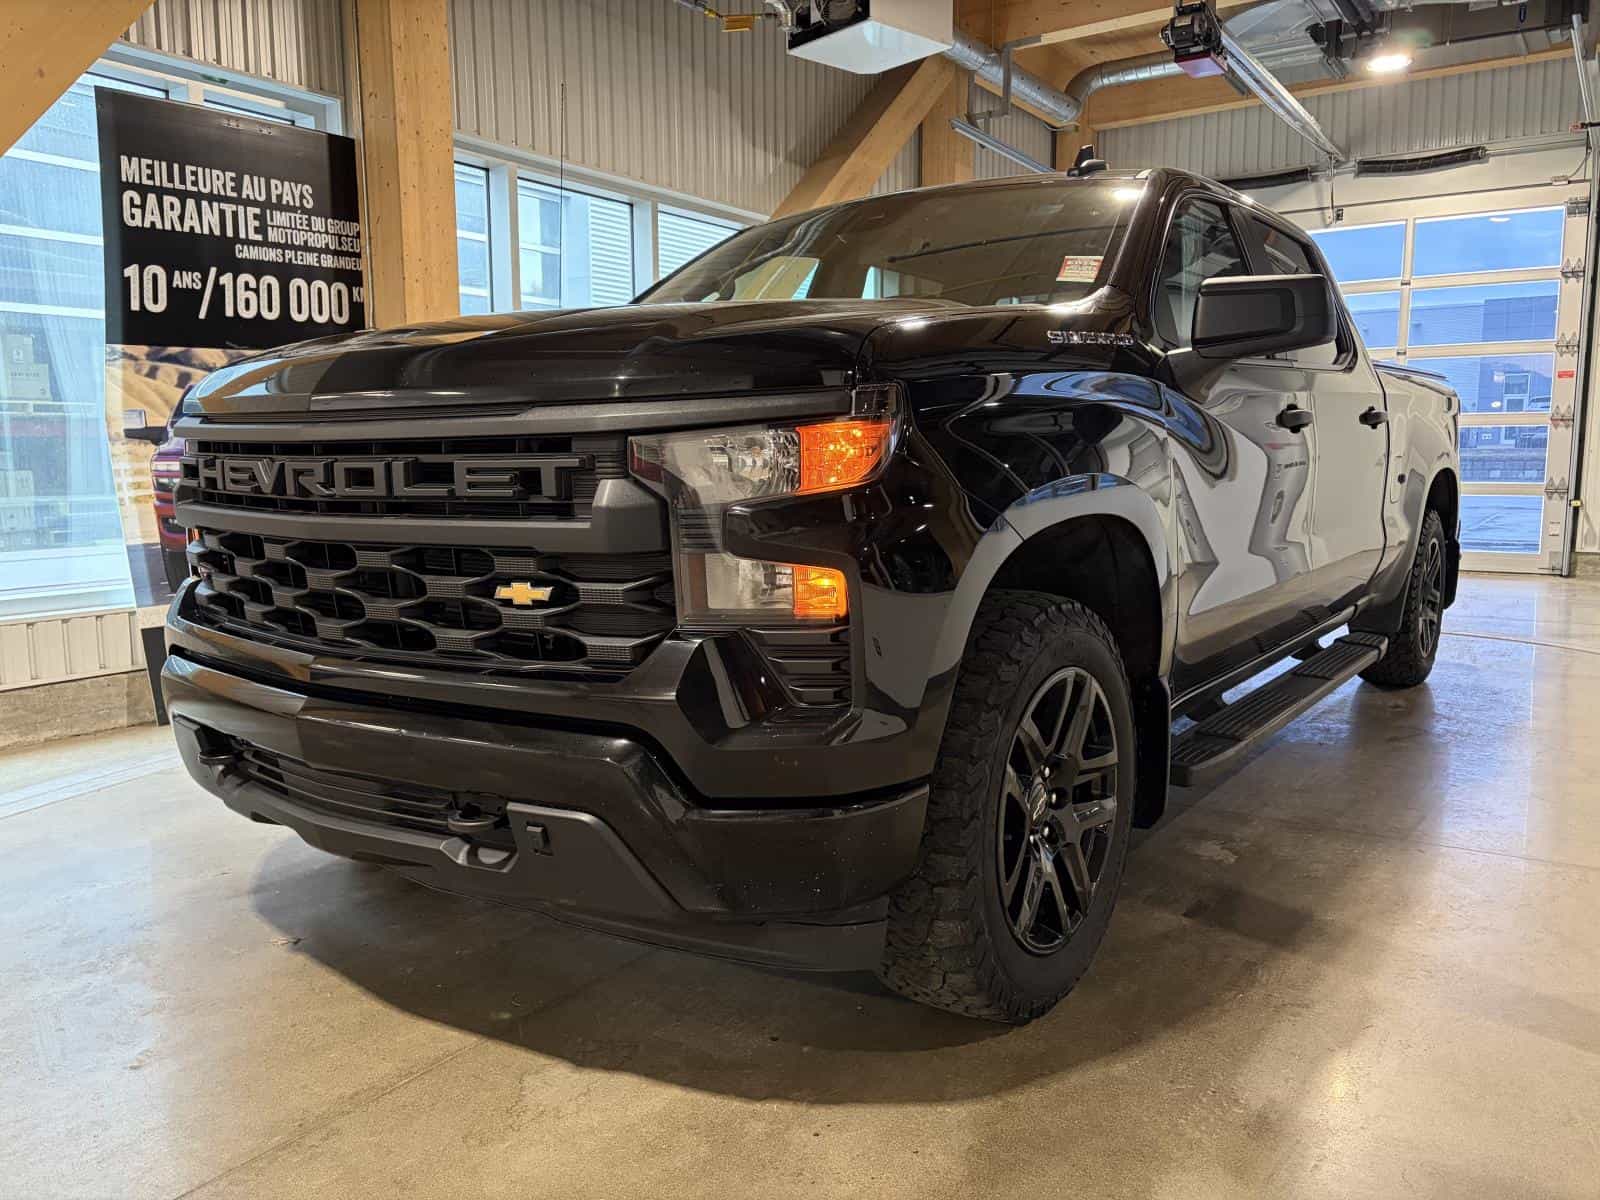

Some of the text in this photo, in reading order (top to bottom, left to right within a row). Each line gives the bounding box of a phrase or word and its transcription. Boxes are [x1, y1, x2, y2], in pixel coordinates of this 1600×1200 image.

[120, 155, 314, 209] MEILLEURE AU PAYS
[122, 190, 263, 241] GARANTIE
[266, 209, 360, 237] LIMITÉE DU GROUP
[235, 243, 362, 271] CAMIONS PLEINE GRANDEU
[267, 227, 361, 253] MOTOPROPULSEU
[123, 263, 168, 313] 10
[289, 277, 350, 325] 000
[179, 454, 595, 500] CHEVROLET
